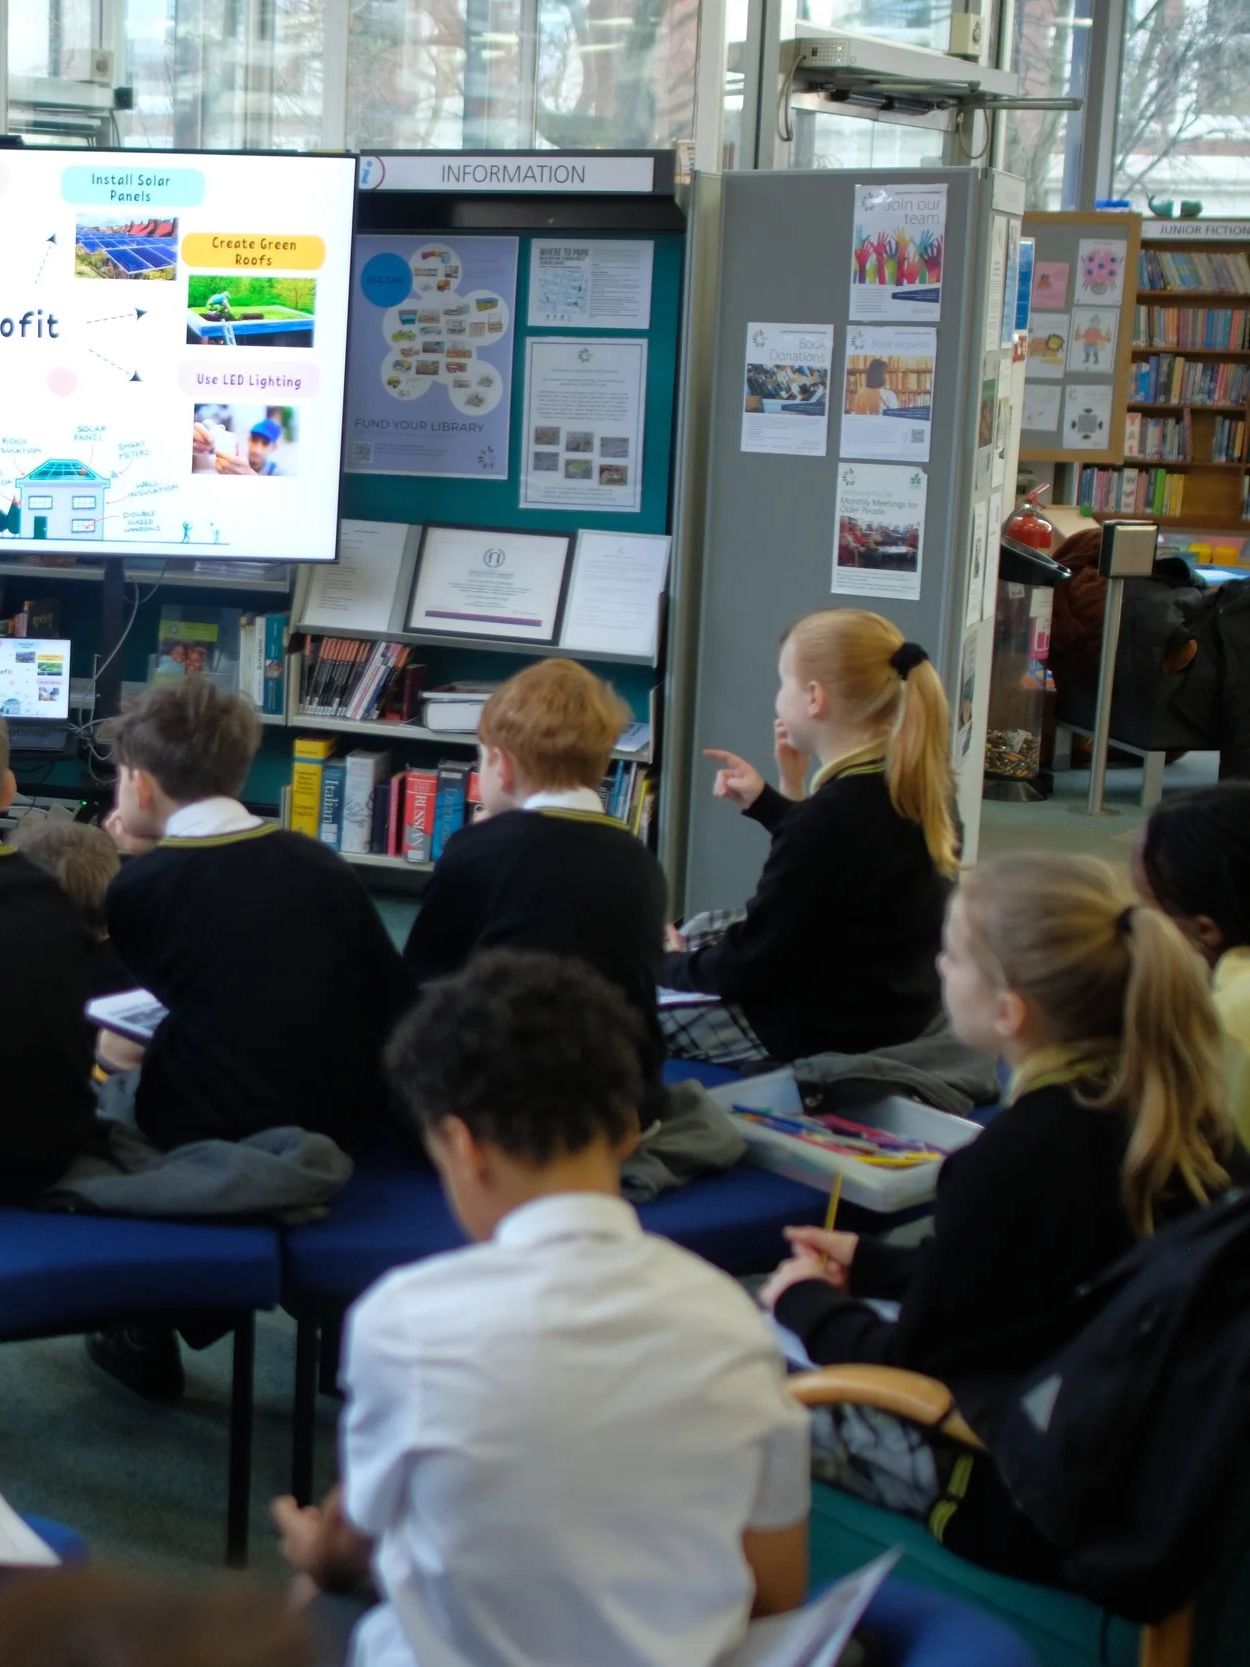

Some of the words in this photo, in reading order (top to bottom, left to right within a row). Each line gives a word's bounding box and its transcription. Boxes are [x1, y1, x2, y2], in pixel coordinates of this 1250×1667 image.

[91, 172, 133, 186] Install
[138, 174, 170, 188] Solar
[442, 164, 586, 184] INFORMATION
[110, 190, 151, 202] Panels
[918, 201, 941, 211] our
[904, 214, 940, 225] team
[1160, 225, 1202, 235] JUNIOR
[1205, 225, 1250, 236] FICTION
[212, 236, 255, 250] Create
[260, 238, 297, 251] Green
[235, 254, 272, 266] Roofs
[799, 338, 826, 350] Book
[770, 349, 826, 363] Donations
[197, 374, 218, 386] Use
[223, 374, 244, 386] LED
[248, 374, 302, 390] Lighting
[354, 418, 390, 430] FUND
[393, 420, 428, 431] YOUR
[431, 421, 485, 432] LIBRARY
[74, 434, 104, 442] PANEL
[323, 780, 340, 825] Italian
[413, 795, 428, 848] RUSSIAN
